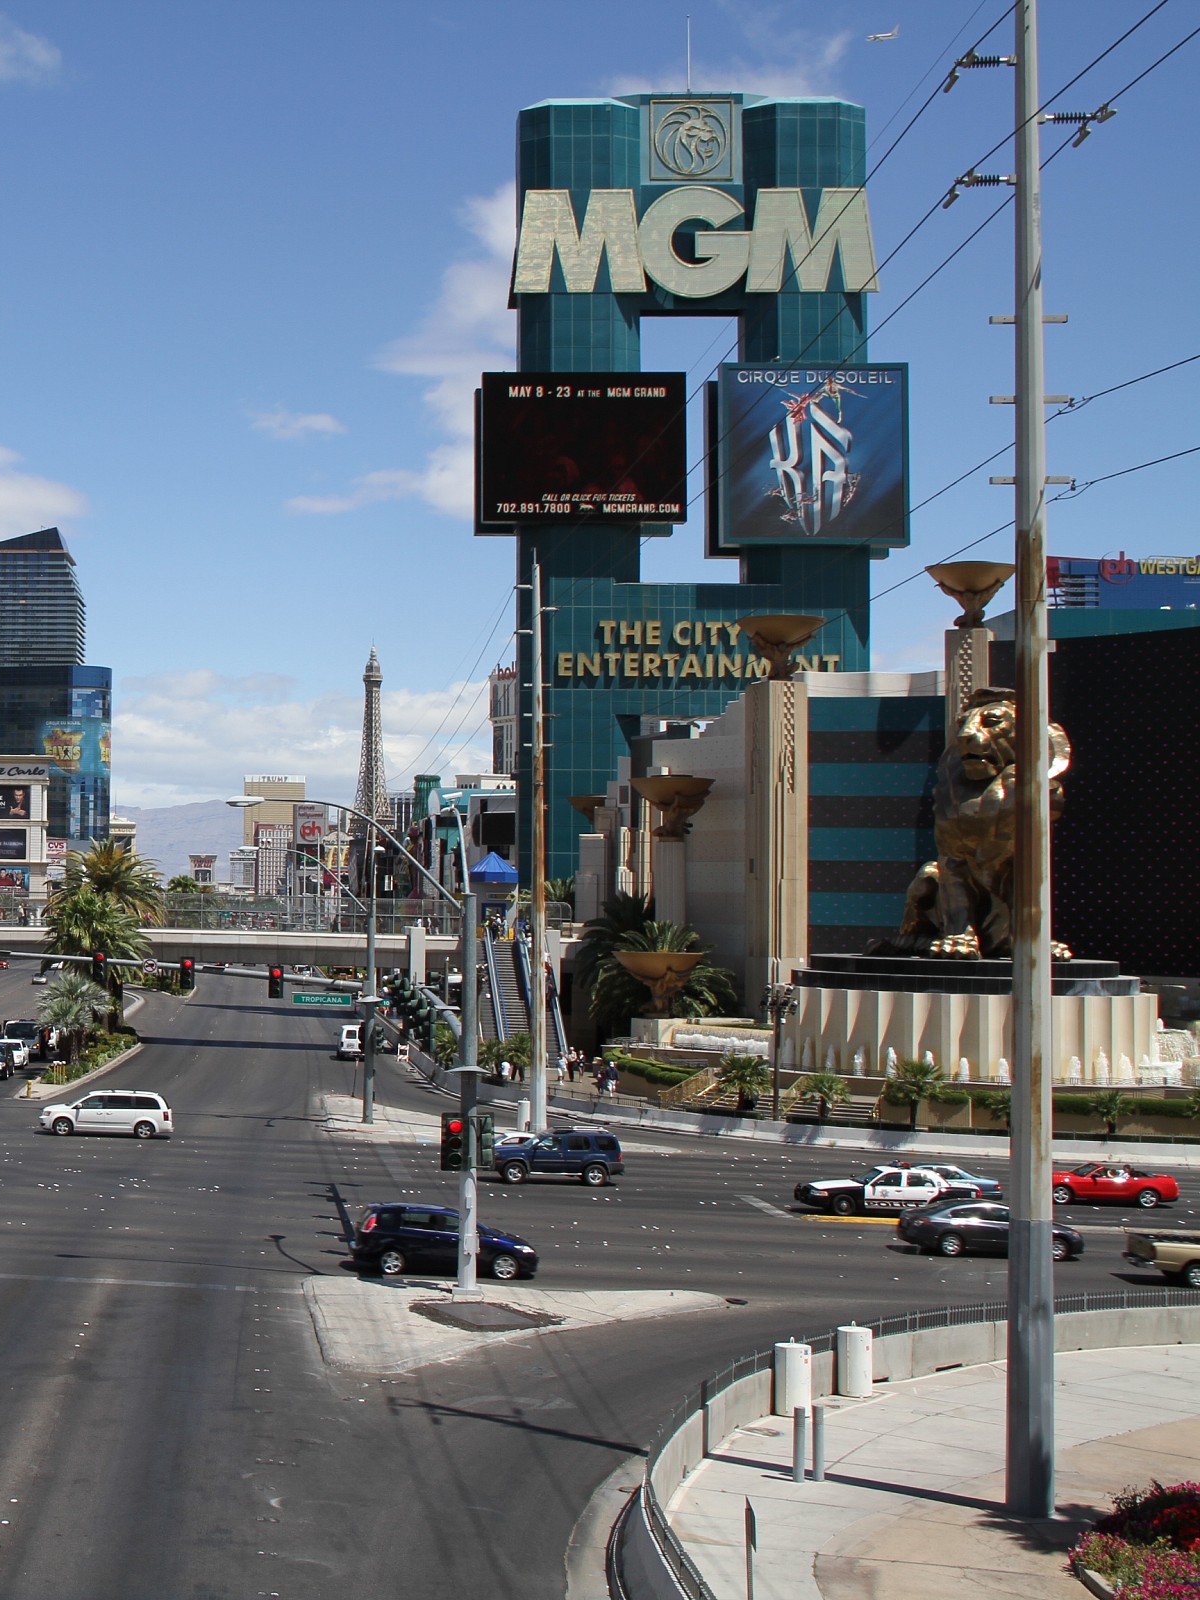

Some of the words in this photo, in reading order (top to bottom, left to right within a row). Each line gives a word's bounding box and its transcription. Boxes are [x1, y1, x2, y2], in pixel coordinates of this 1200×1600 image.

[513, 186, 880, 298] MGM
[737, 371, 799, 387] CIRQUE
[806, 372, 829, 384] DU
[835, 372, 892, 384] SOLEIL
[508, 386, 531, 398] MAY
[536, 386, 543, 397] 8
[556, 387, 571, 397] 23
[607, 387, 631, 397] MGM
[634, 387, 666, 397] GRAND
[497, 503, 570, 513] 702.891.7800
[1138, 558, 1200, 575] WESTG
[599, 620, 662, 645] THE
[672, 620, 742, 646] CITY
[557, 652, 841, 678] ENTERTAINMNT
[7, 766, 46, 776] Carlo
